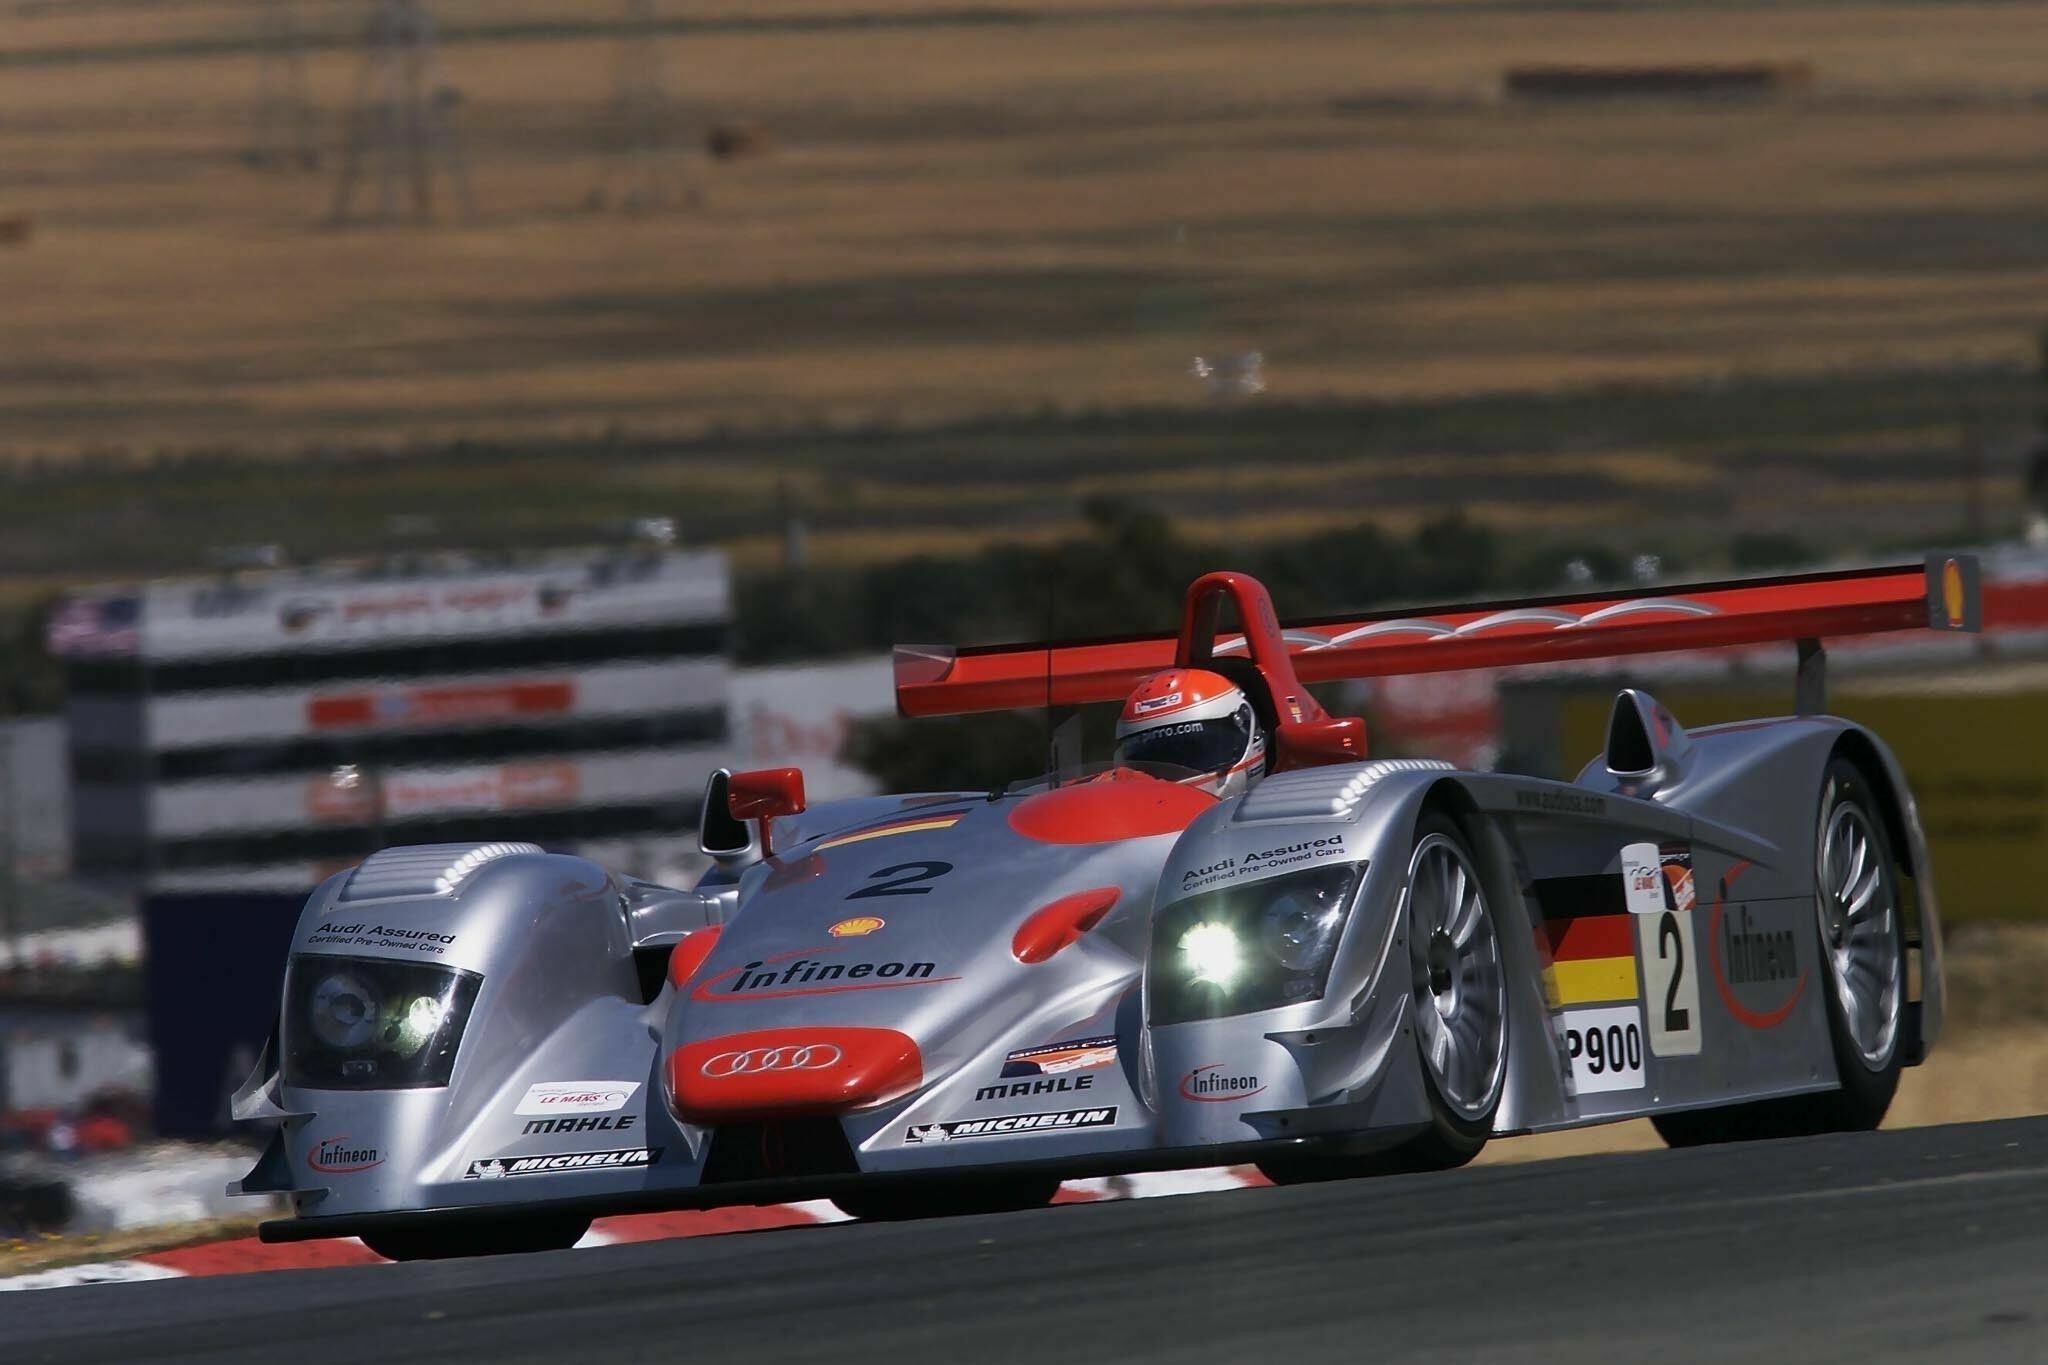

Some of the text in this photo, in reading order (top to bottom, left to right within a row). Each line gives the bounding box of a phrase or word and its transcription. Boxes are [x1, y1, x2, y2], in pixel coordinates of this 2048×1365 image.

[1182, 834, 1343, 882] Audi Assured
[1183, 847, 1345, 892] Certified Pre-Owned Cars
[845, 860, 953, 900] 2
[308, 935, 445, 954] Certified Pre-Owned Cars
[316, 922, 457, 944] Audi Assured
[1658, 911, 1689, 1031] 2
[540, 1094, 601, 1104] LE MANS
[975, 1074, 1094, 1101] MAHLE
[521, 1115, 637, 1135] MAHLE
[953, 1110, 1110, 1134] MICHELIN
[509, 1151, 655, 1172] MICHELIN
